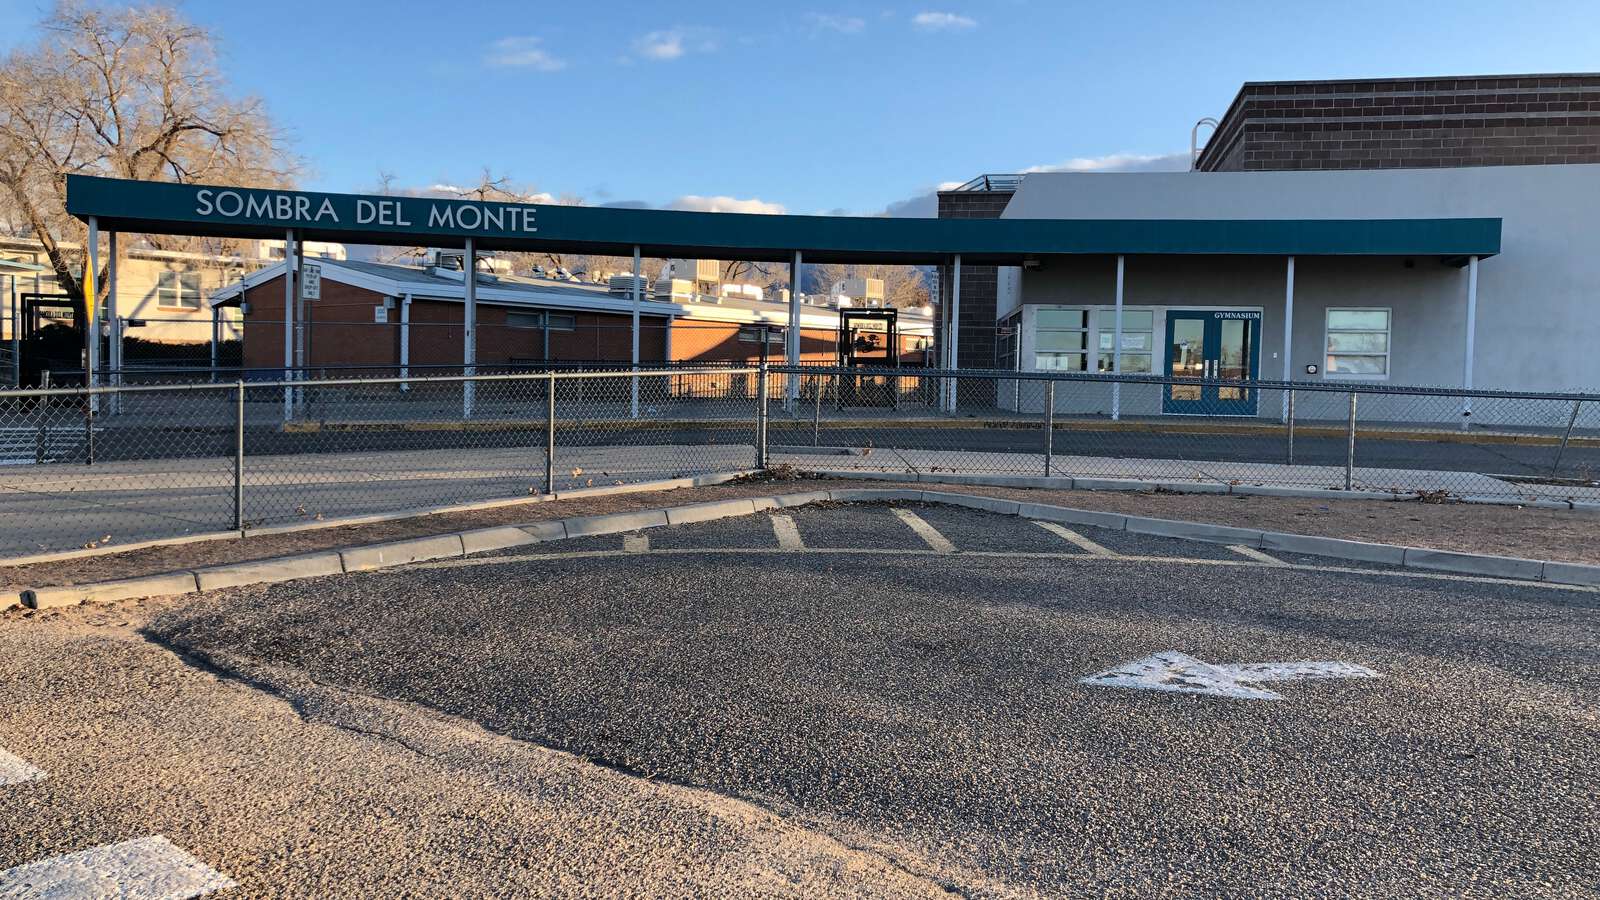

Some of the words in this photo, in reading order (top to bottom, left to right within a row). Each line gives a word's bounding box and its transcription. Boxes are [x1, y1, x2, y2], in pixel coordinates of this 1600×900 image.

[196, 189, 339, 223] SOMBRA
[356, 199, 411, 226] DEL
[427, 203, 538, 232] MONTE
[1214, 311, 1260, 319] GYMNASIUM
